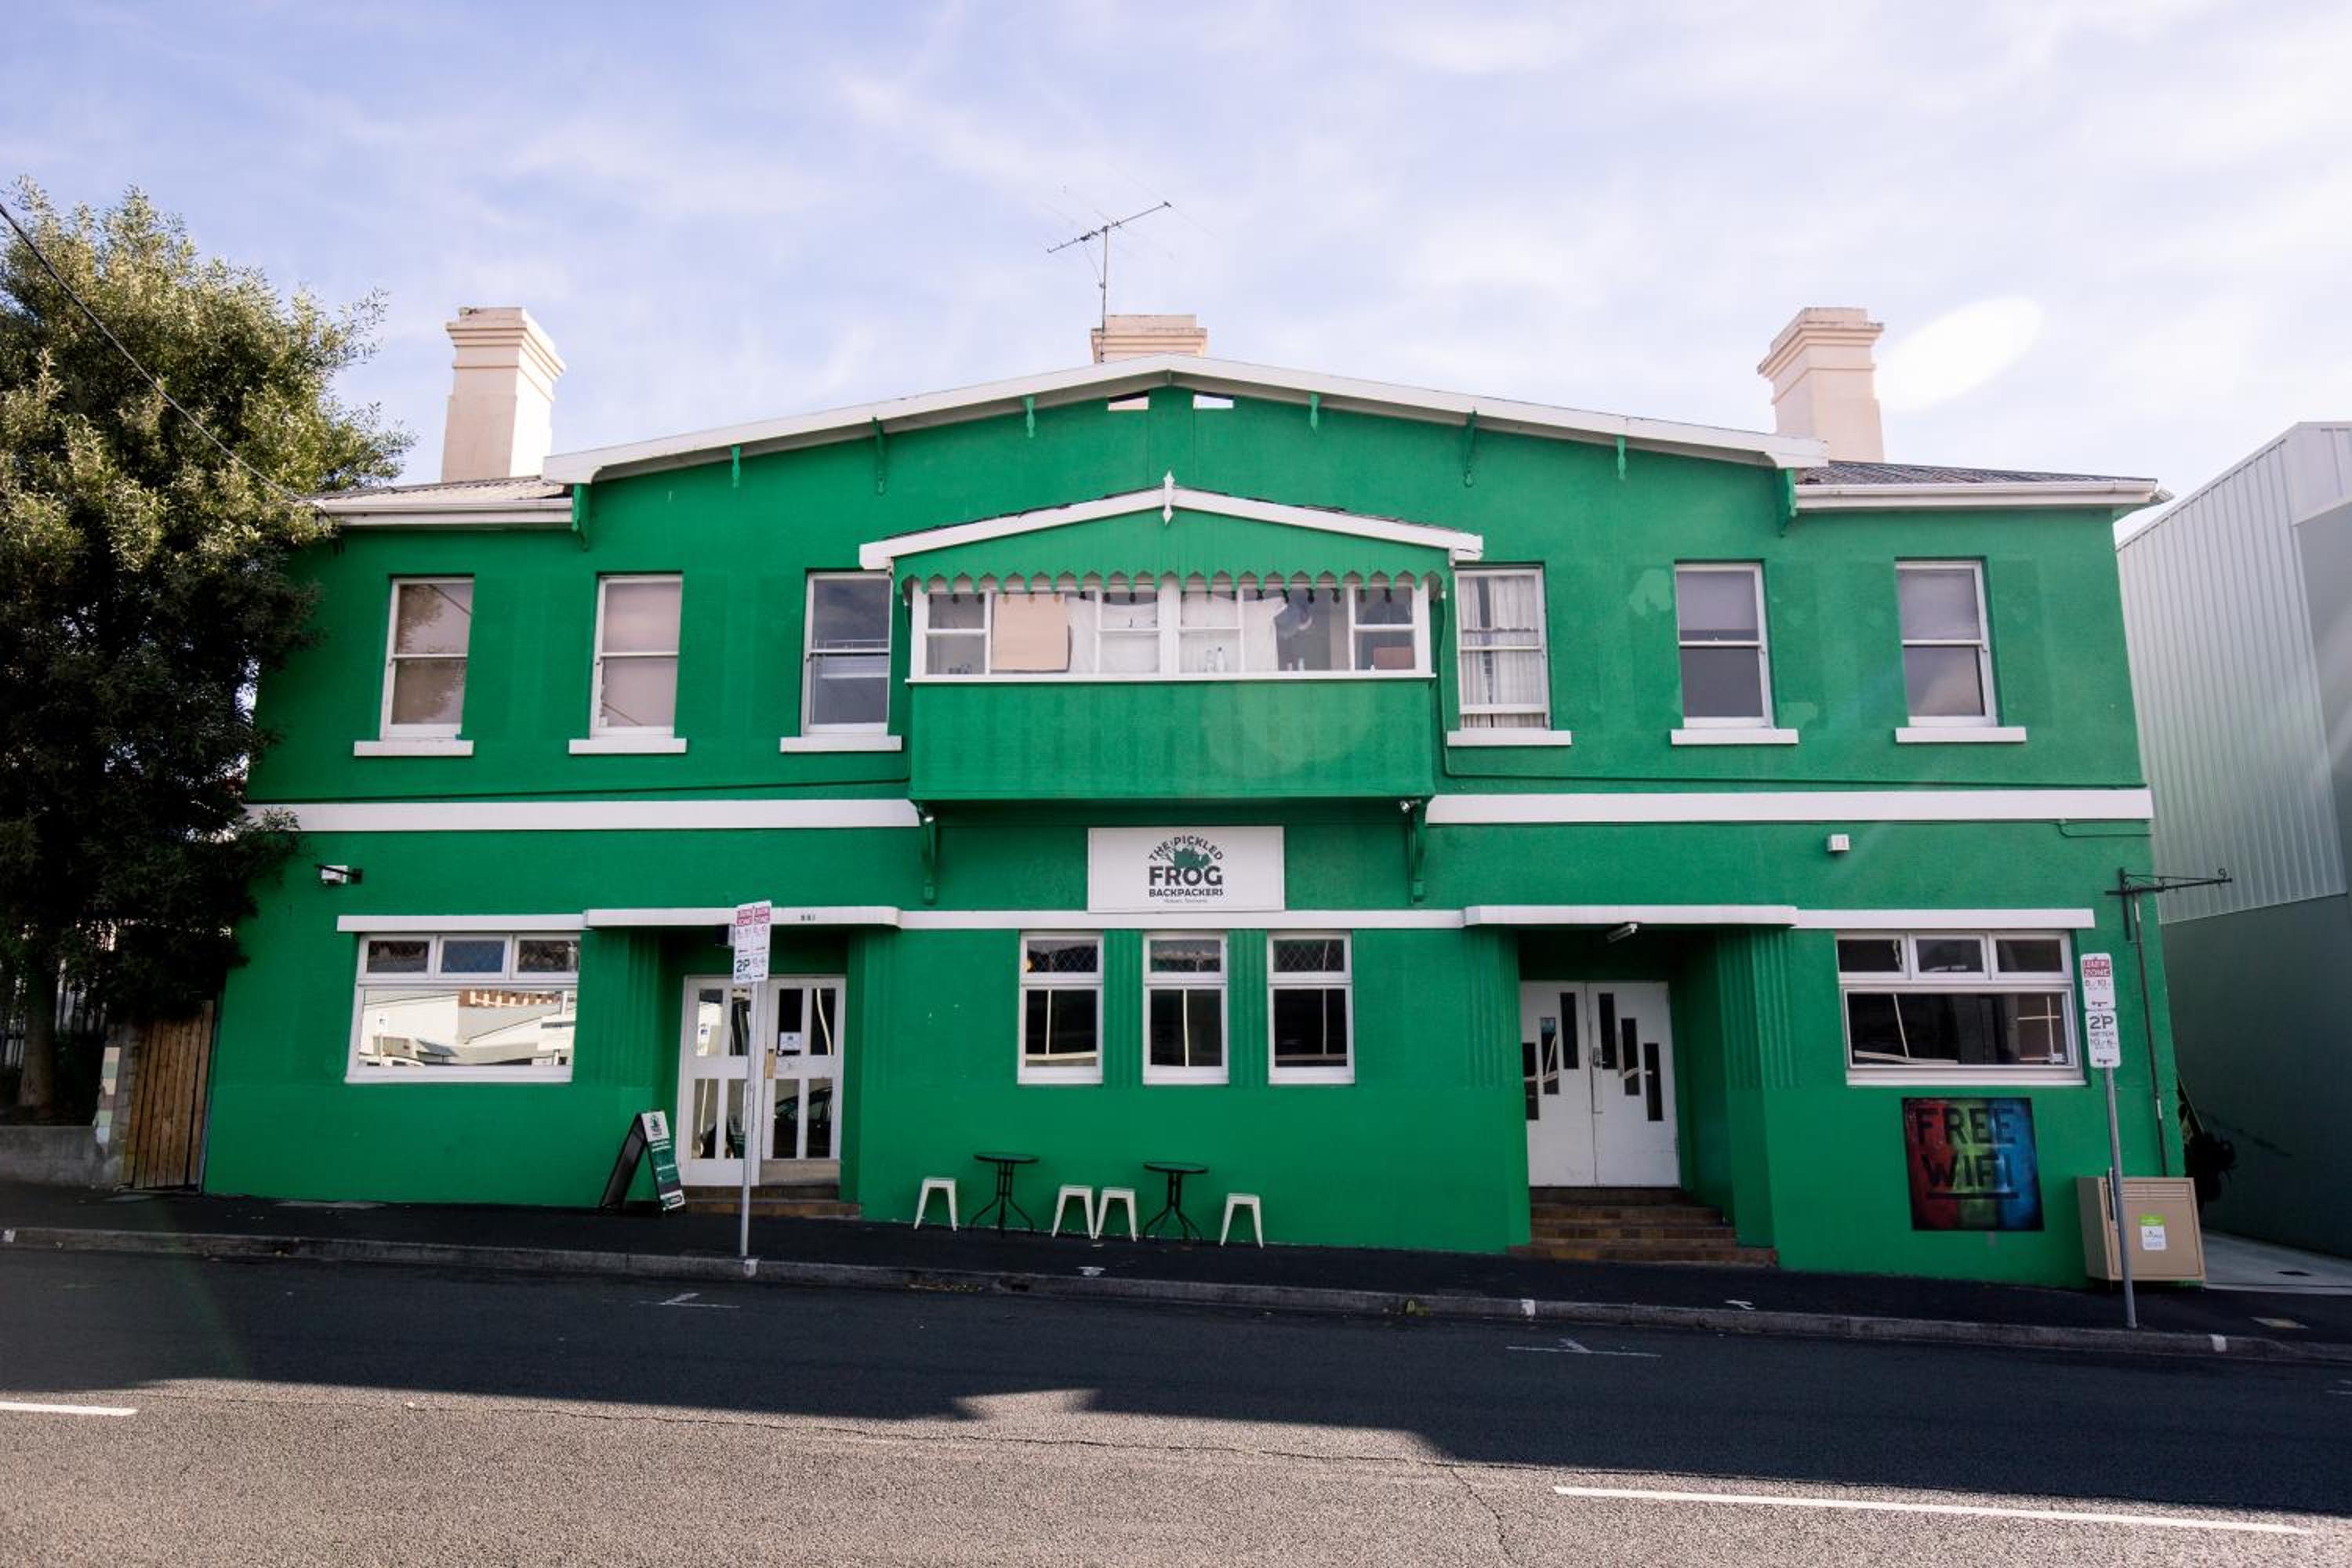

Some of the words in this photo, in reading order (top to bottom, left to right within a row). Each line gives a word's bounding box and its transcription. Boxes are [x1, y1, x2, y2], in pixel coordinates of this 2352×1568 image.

[1149, 840, 1171, 861] THE
[1174, 835, 1223, 860] PICKLED
[1149, 865, 1222, 886] FROG
[1149, 888, 1224, 897] BACKPACKERS
[736, 959, 750, 972] 2P
[2089, 1015, 2114, 1029] 2P
[1916, 1107, 2017, 1145] FREE
[1921, 1153, 2014, 1187] WIFI
